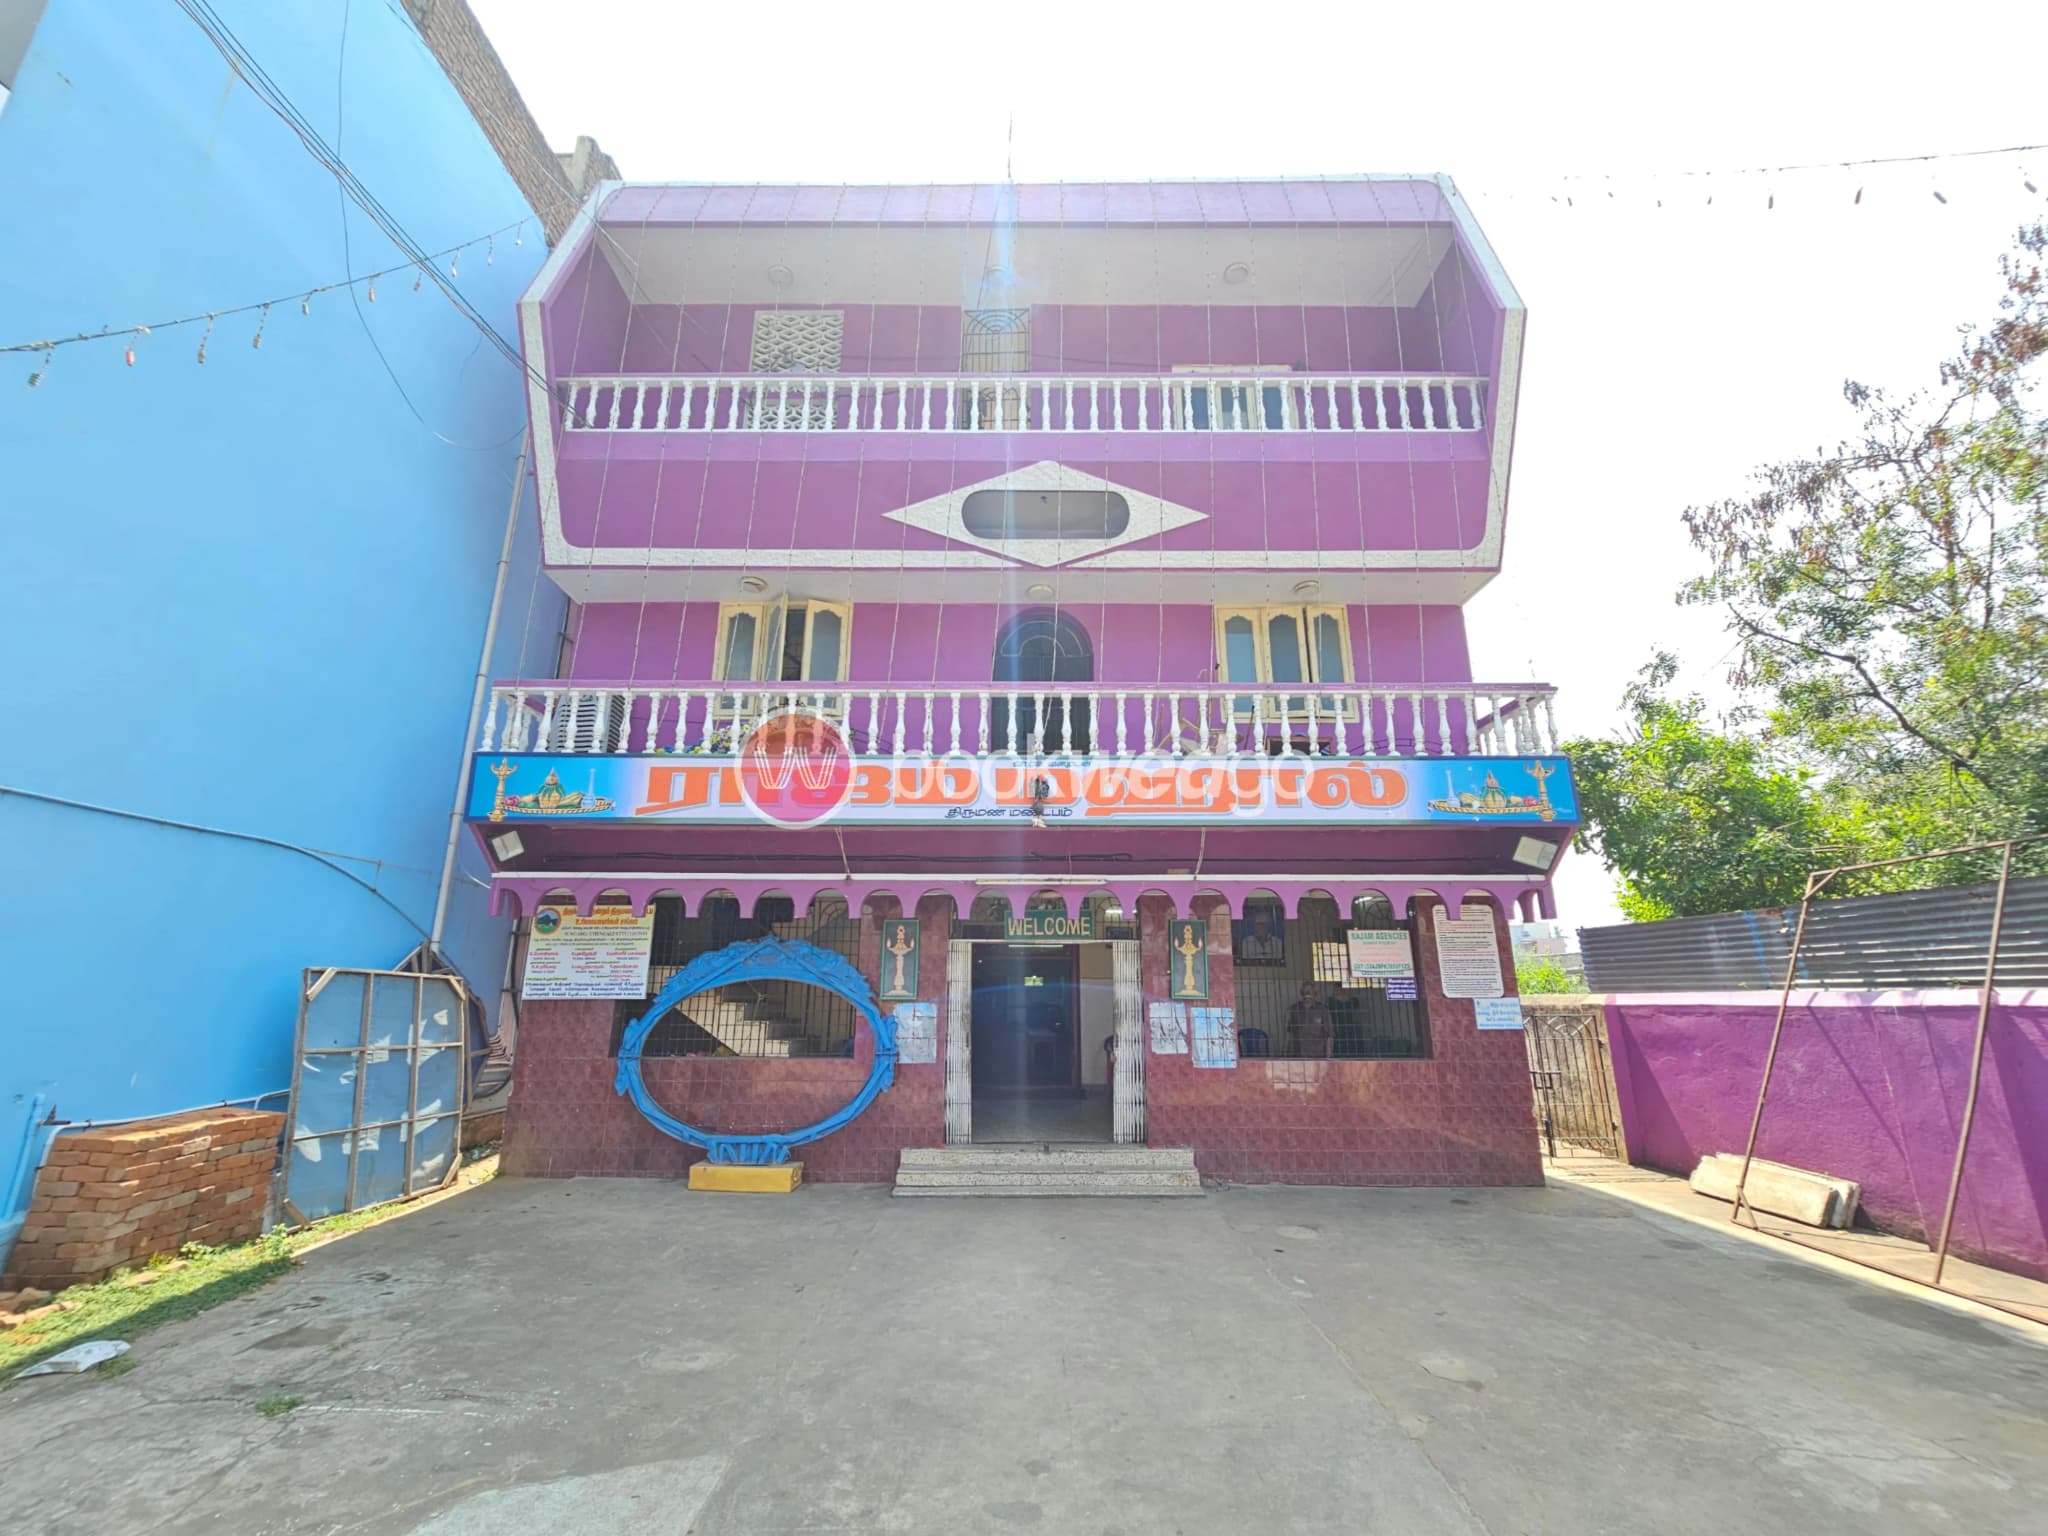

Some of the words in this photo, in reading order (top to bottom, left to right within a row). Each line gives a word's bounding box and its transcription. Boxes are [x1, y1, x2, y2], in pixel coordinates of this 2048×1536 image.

[634, 760, 980, 816] ராஜம்
[995, 761, 1408, 817] மஹால்
[944, 806, 1006, 819] திருமண
[1008, 916, 1091, 937] WELCOME
